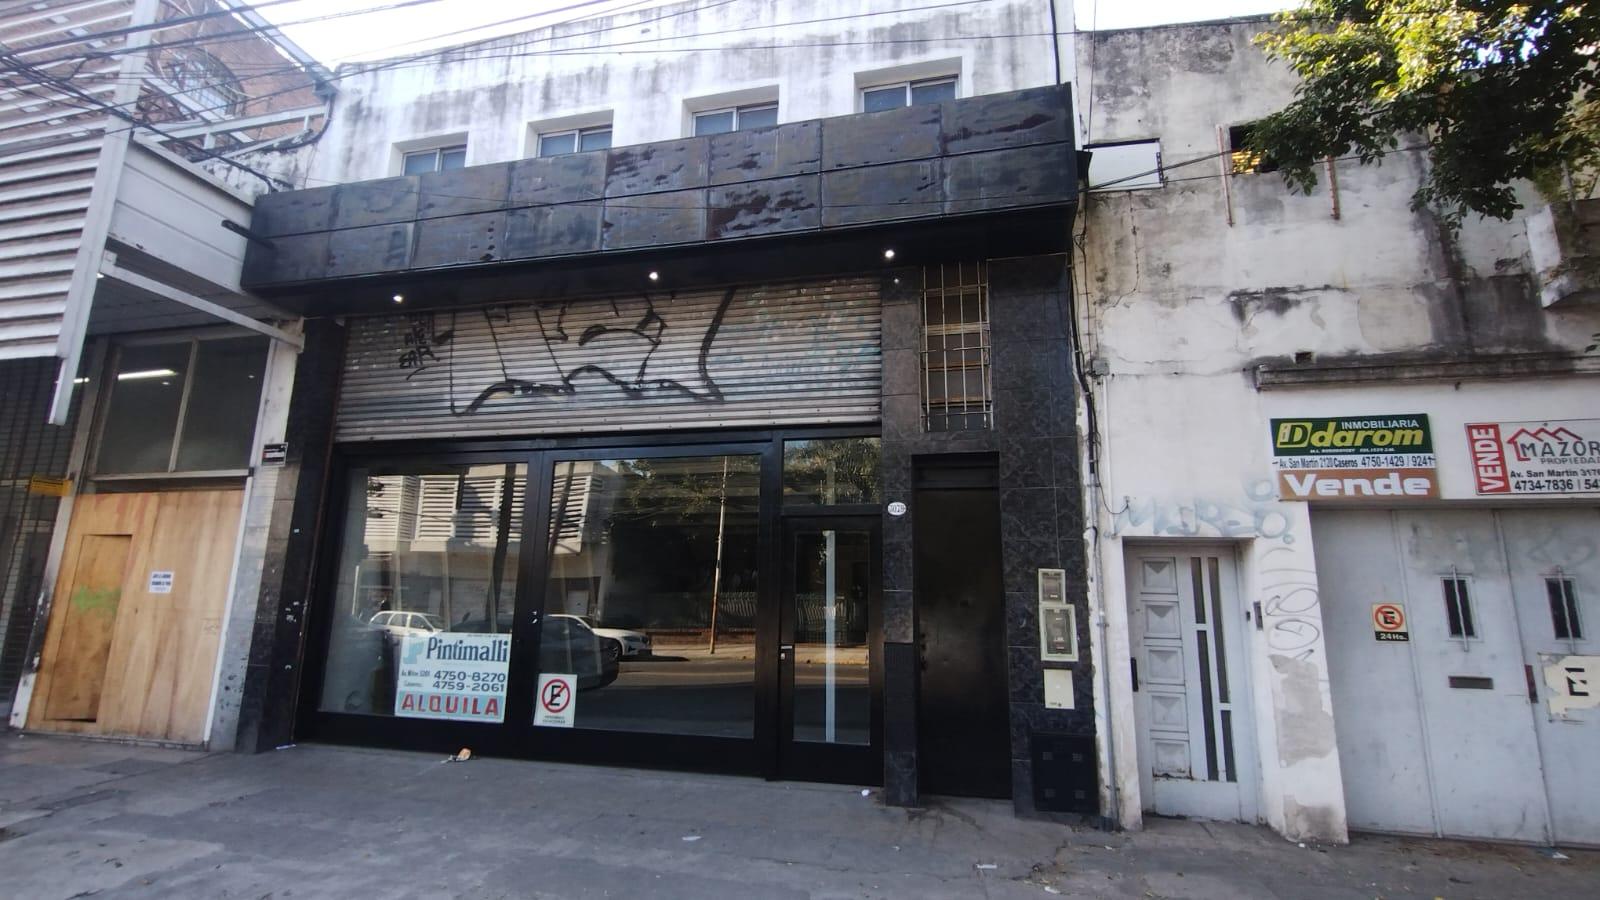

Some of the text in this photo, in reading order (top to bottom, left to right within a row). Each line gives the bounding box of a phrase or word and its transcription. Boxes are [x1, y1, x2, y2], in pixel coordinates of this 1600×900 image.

[1341, 420, 1419, 429] INMOBILIARIA
[1310, 422, 1424, 447] darom
[1279, 458, 1287, 467] Av.
[1288, 458, 1299, 468] San
[1333, 457, 1358, 467] Caseros
[1361, 456, 1405, 467] 4750-1429
[1471, 428, 1505, 491] VENDE
[1284, 473, 1431, 497] Vende
[1514, 479, 1600, 491] 4734-7836 54
[426, 636, 509, 663] Pintimalli
[434, 670, 506, 683] 4750-8270
[432, 681, 505, 692] 4759-2061
[401, 694, 499, 716] ALQUILA
